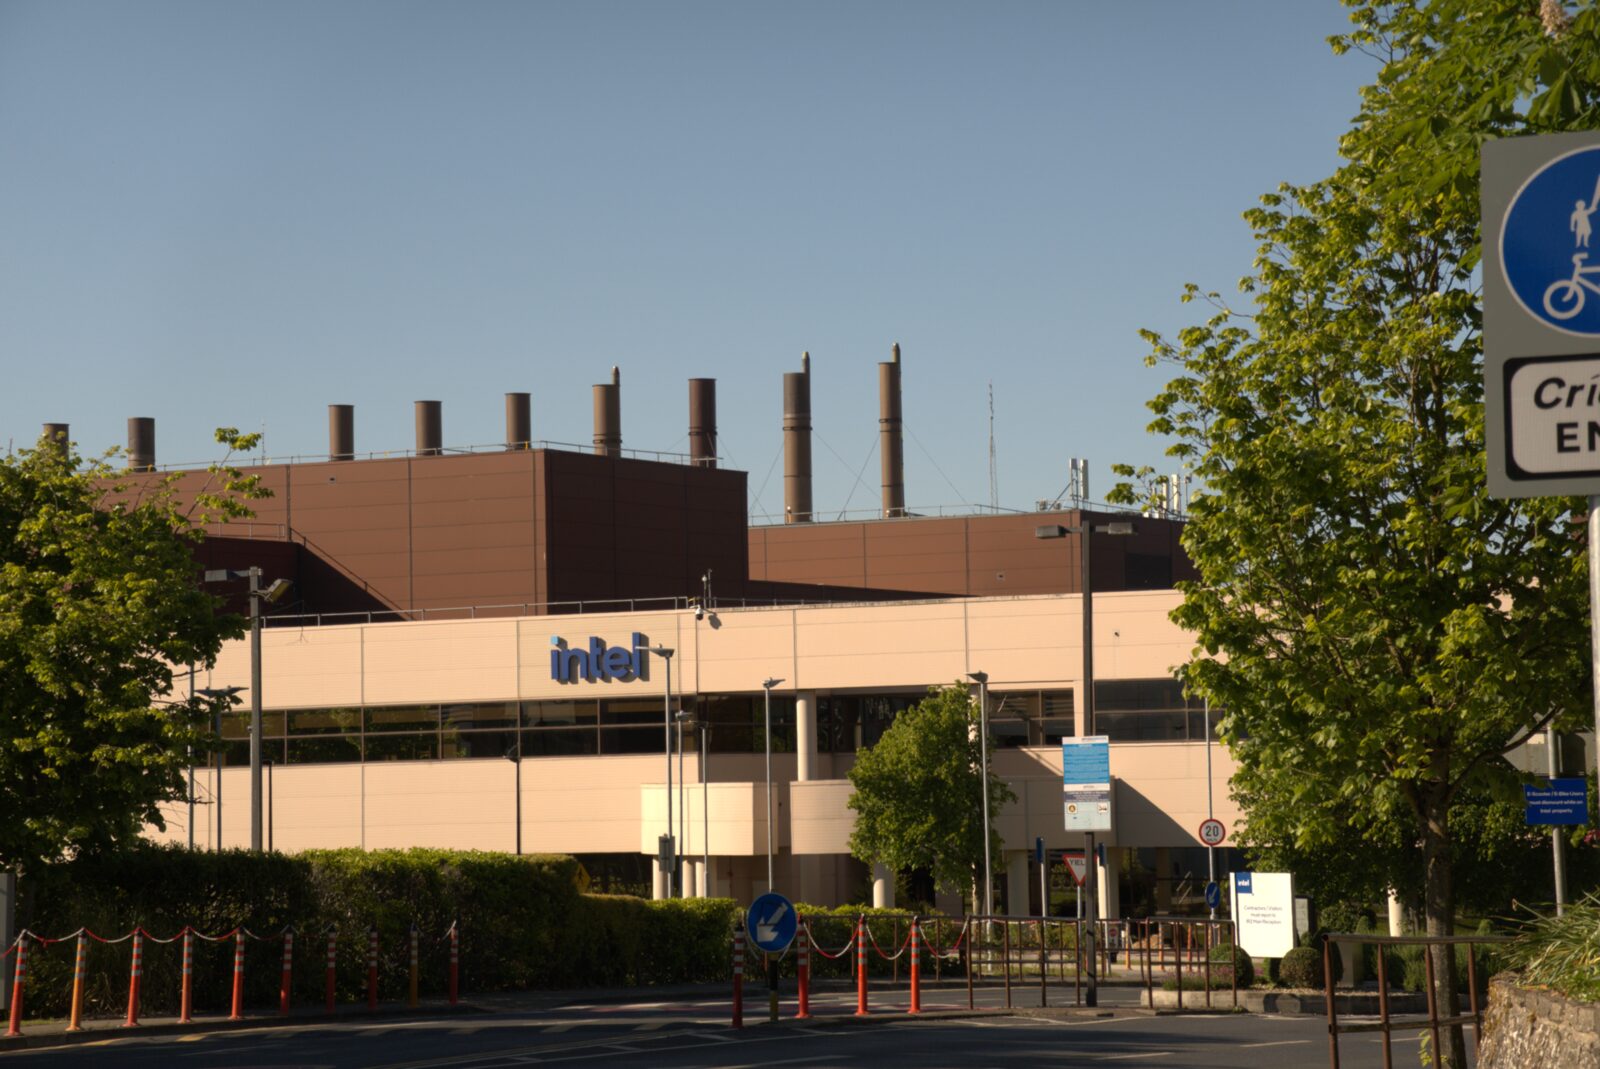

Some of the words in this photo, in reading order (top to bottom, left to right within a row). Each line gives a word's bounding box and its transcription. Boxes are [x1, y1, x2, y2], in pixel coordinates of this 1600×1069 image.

[1534, 373, 1600, 409] Crí
[550, 632, 645, 682] intel
[1205, 825, 1219, 837] 20
[1070, 858, 1086, 866] YIEL
